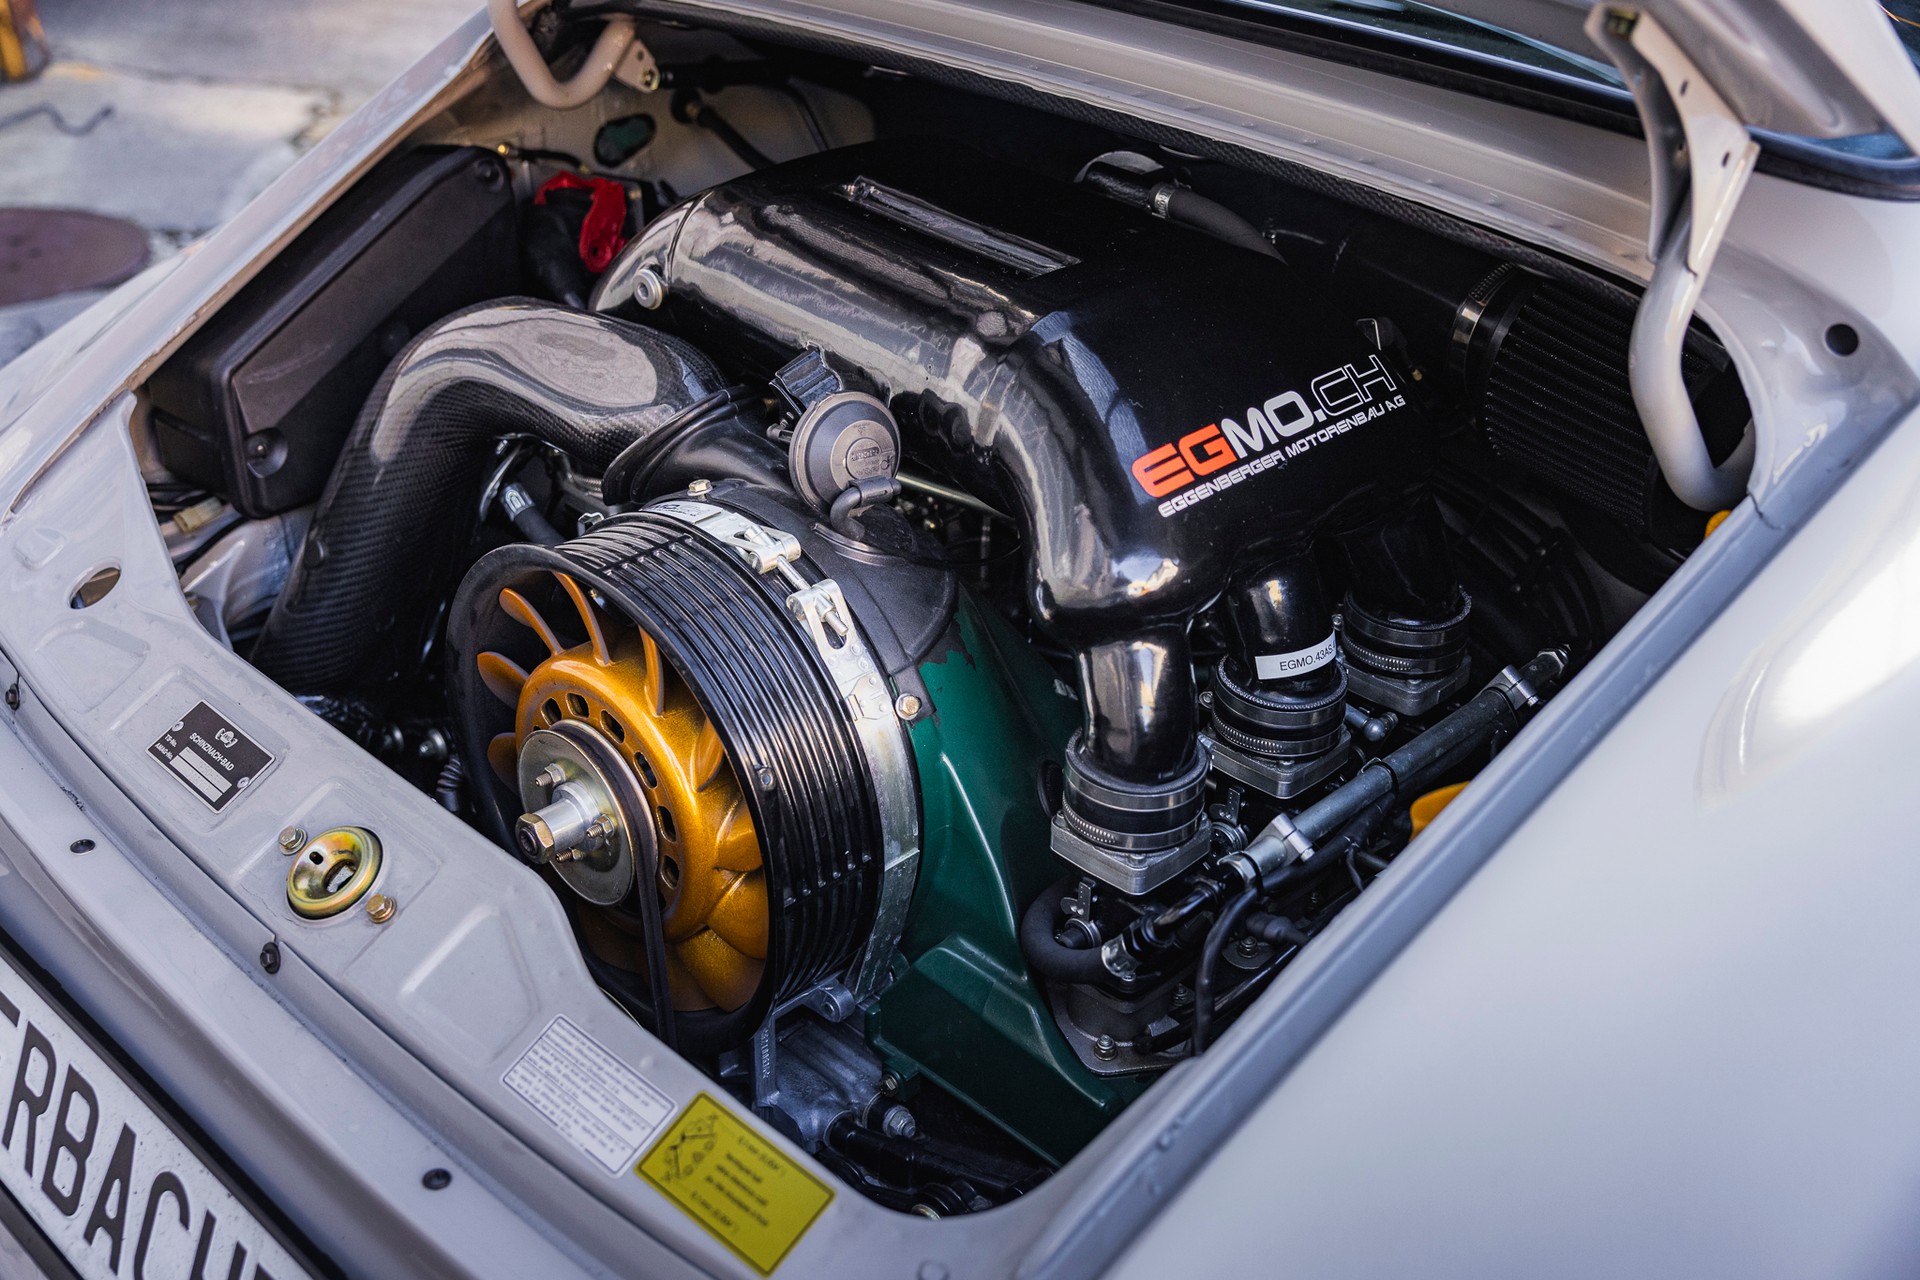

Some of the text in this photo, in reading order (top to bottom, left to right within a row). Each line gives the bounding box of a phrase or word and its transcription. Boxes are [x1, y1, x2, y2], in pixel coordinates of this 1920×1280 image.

[1131, 354, 1397, 498] EGMO.CH
[1157, 395, 1407, 518] EGGENBERGER MOTORENBAU AG
[190, 733, 234, 770] SCHINZNACH-BAD
